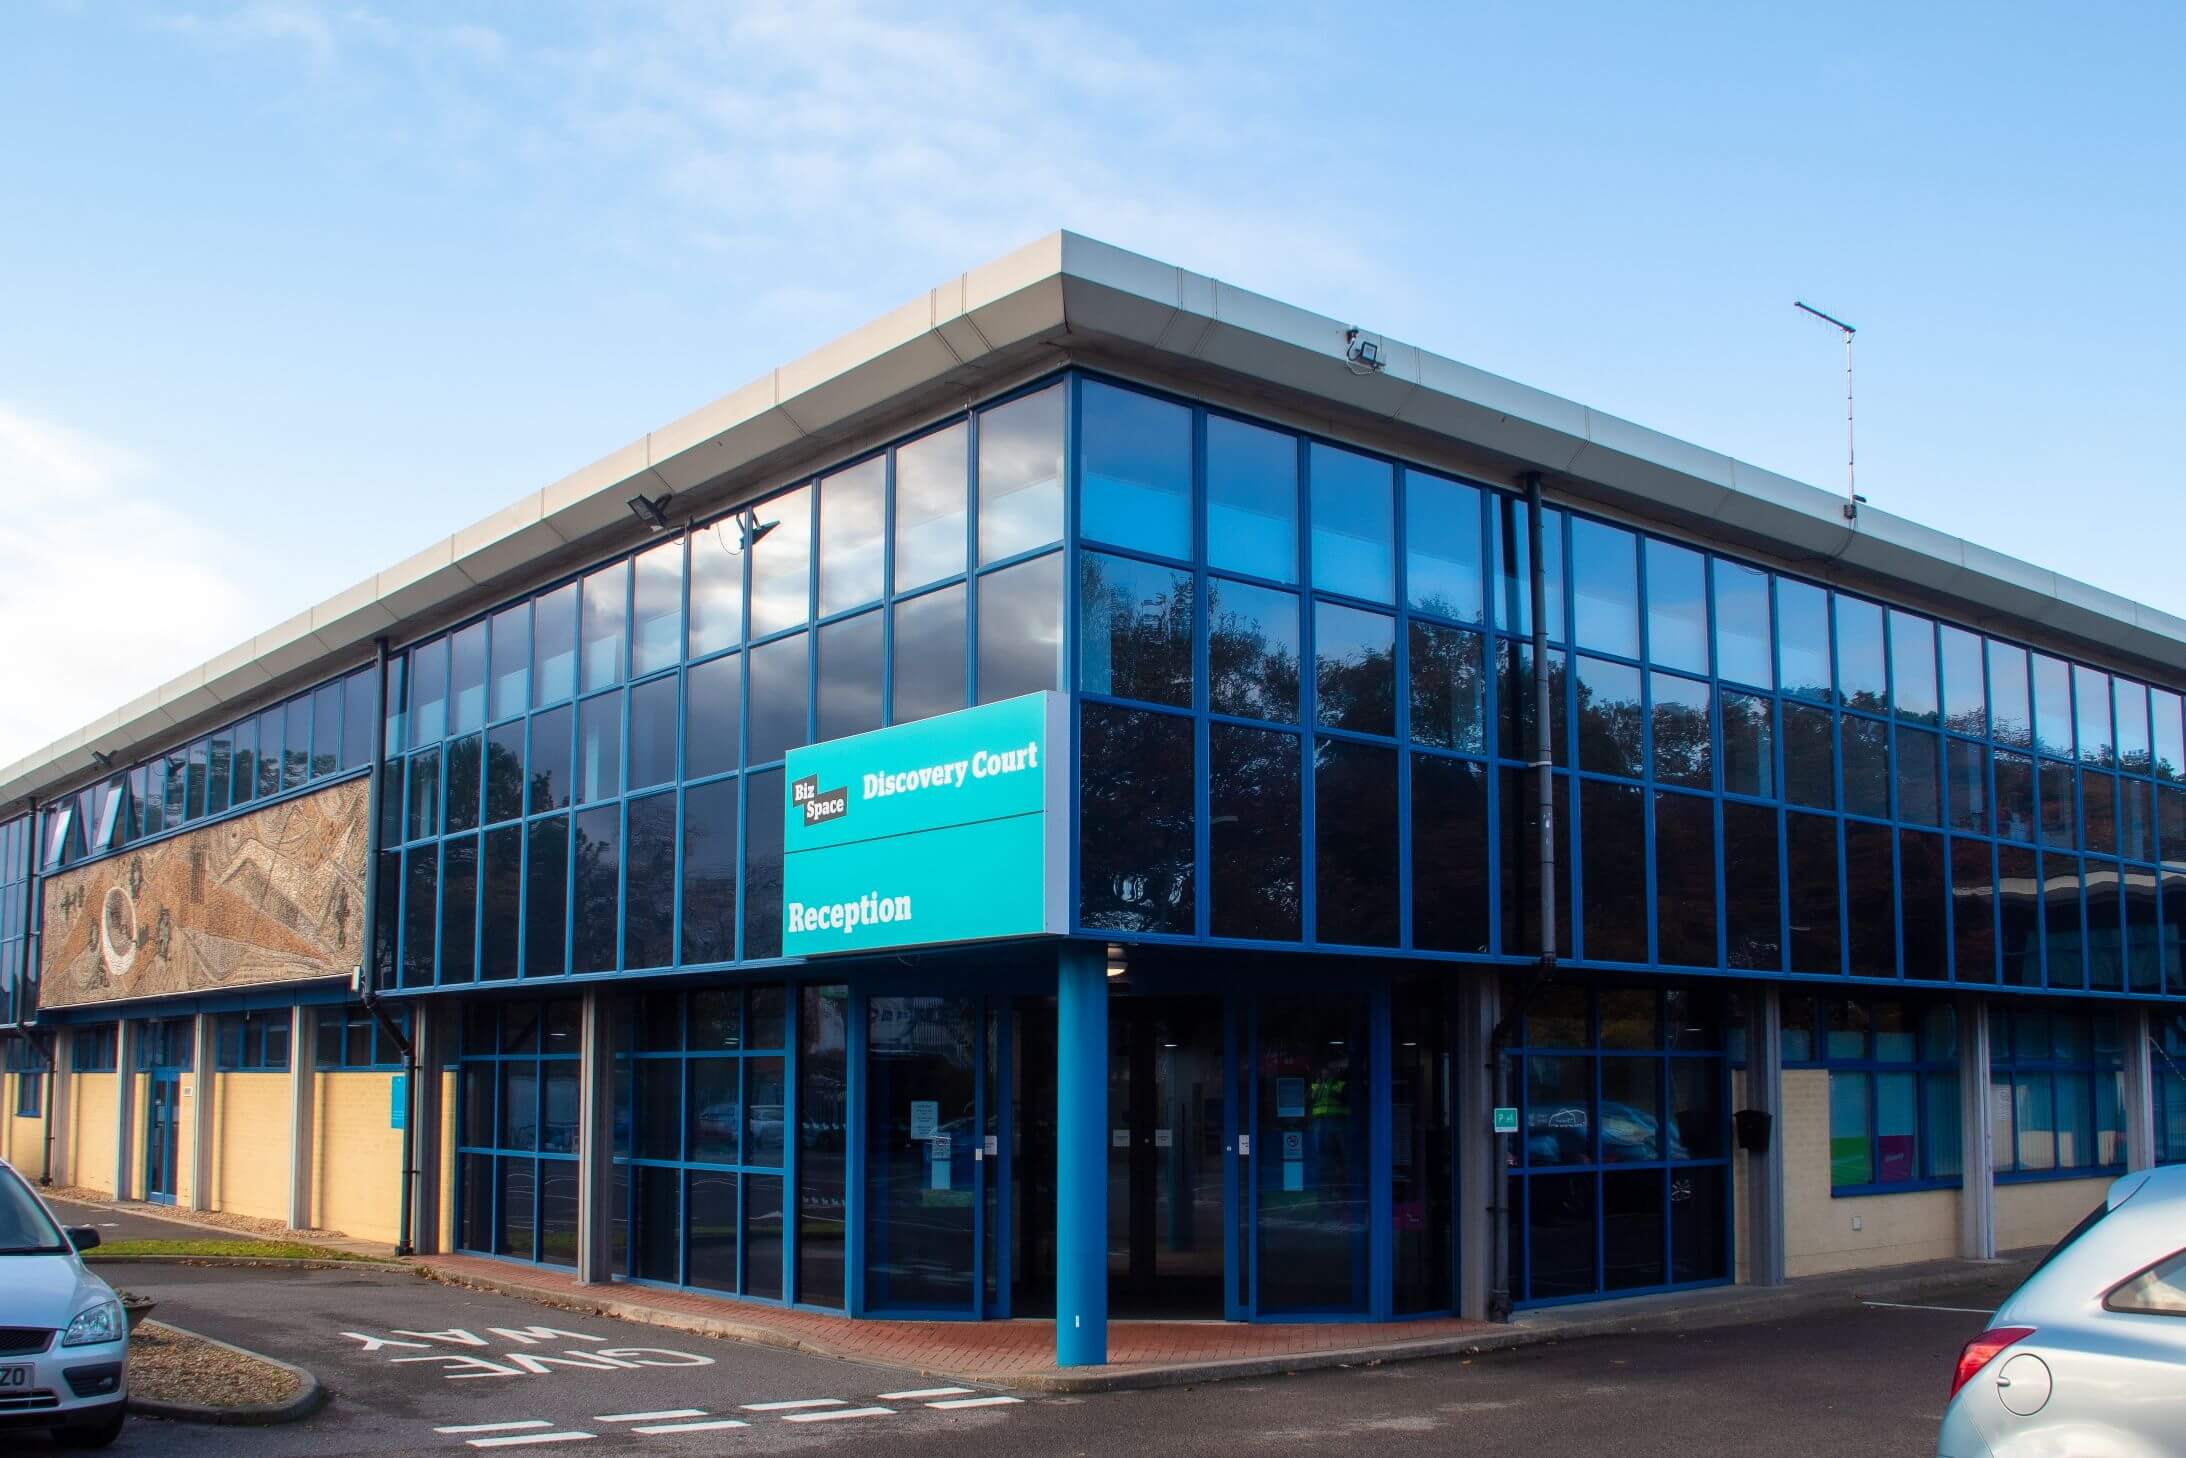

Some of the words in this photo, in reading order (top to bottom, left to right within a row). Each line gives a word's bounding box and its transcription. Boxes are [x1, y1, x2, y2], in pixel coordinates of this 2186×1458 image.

[863, 760, 968, 800] Discovery
[972, 741, 1038, 778] Court
[794, 782, 815, 802] Biz
[806, 797, 844, 820] Space
[788, 891, 912, 934] Reception
[338, 1326, 609, 1351] WAY
[388, 1347, 716, 1379] GIVE
